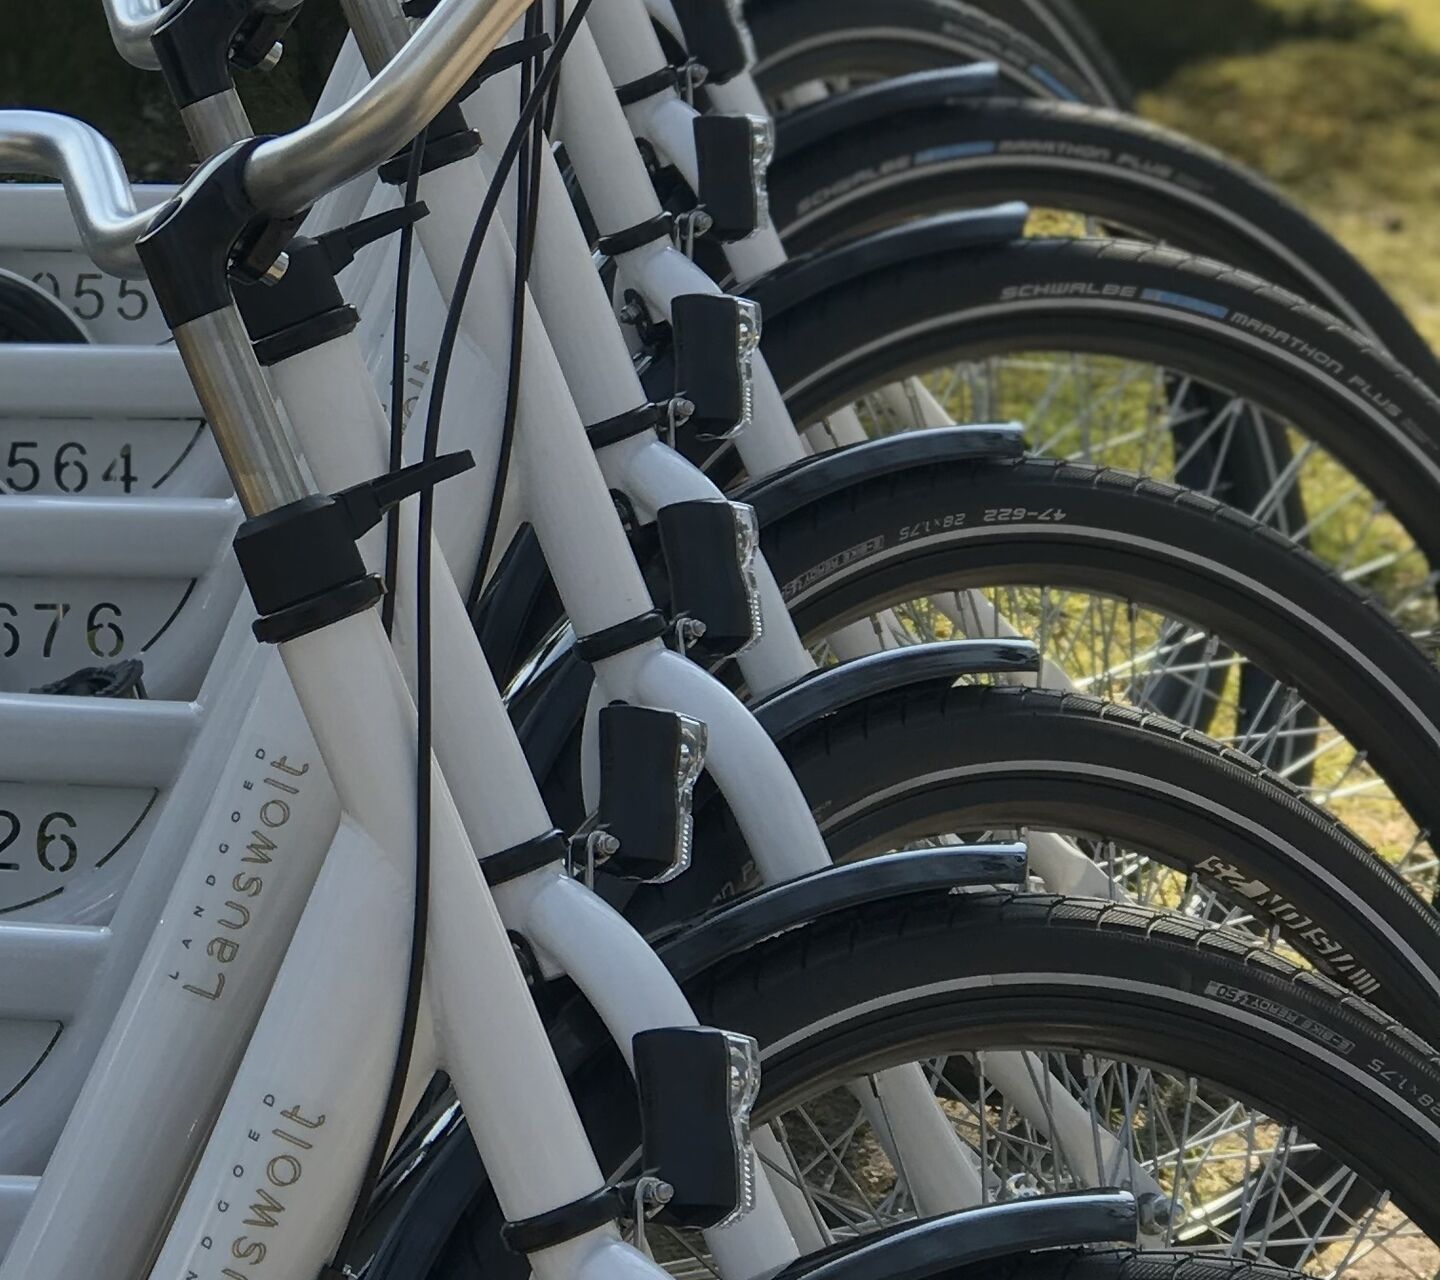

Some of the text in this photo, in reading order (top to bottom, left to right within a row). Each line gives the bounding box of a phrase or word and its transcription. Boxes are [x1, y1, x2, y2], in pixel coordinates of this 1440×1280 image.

[1000, 282, 1402, 419] SCHWALBE MARATHON PLUS
[983, 507, 1067, 522] 47-622
[182, 754, 310, 1001] Lauswolt
